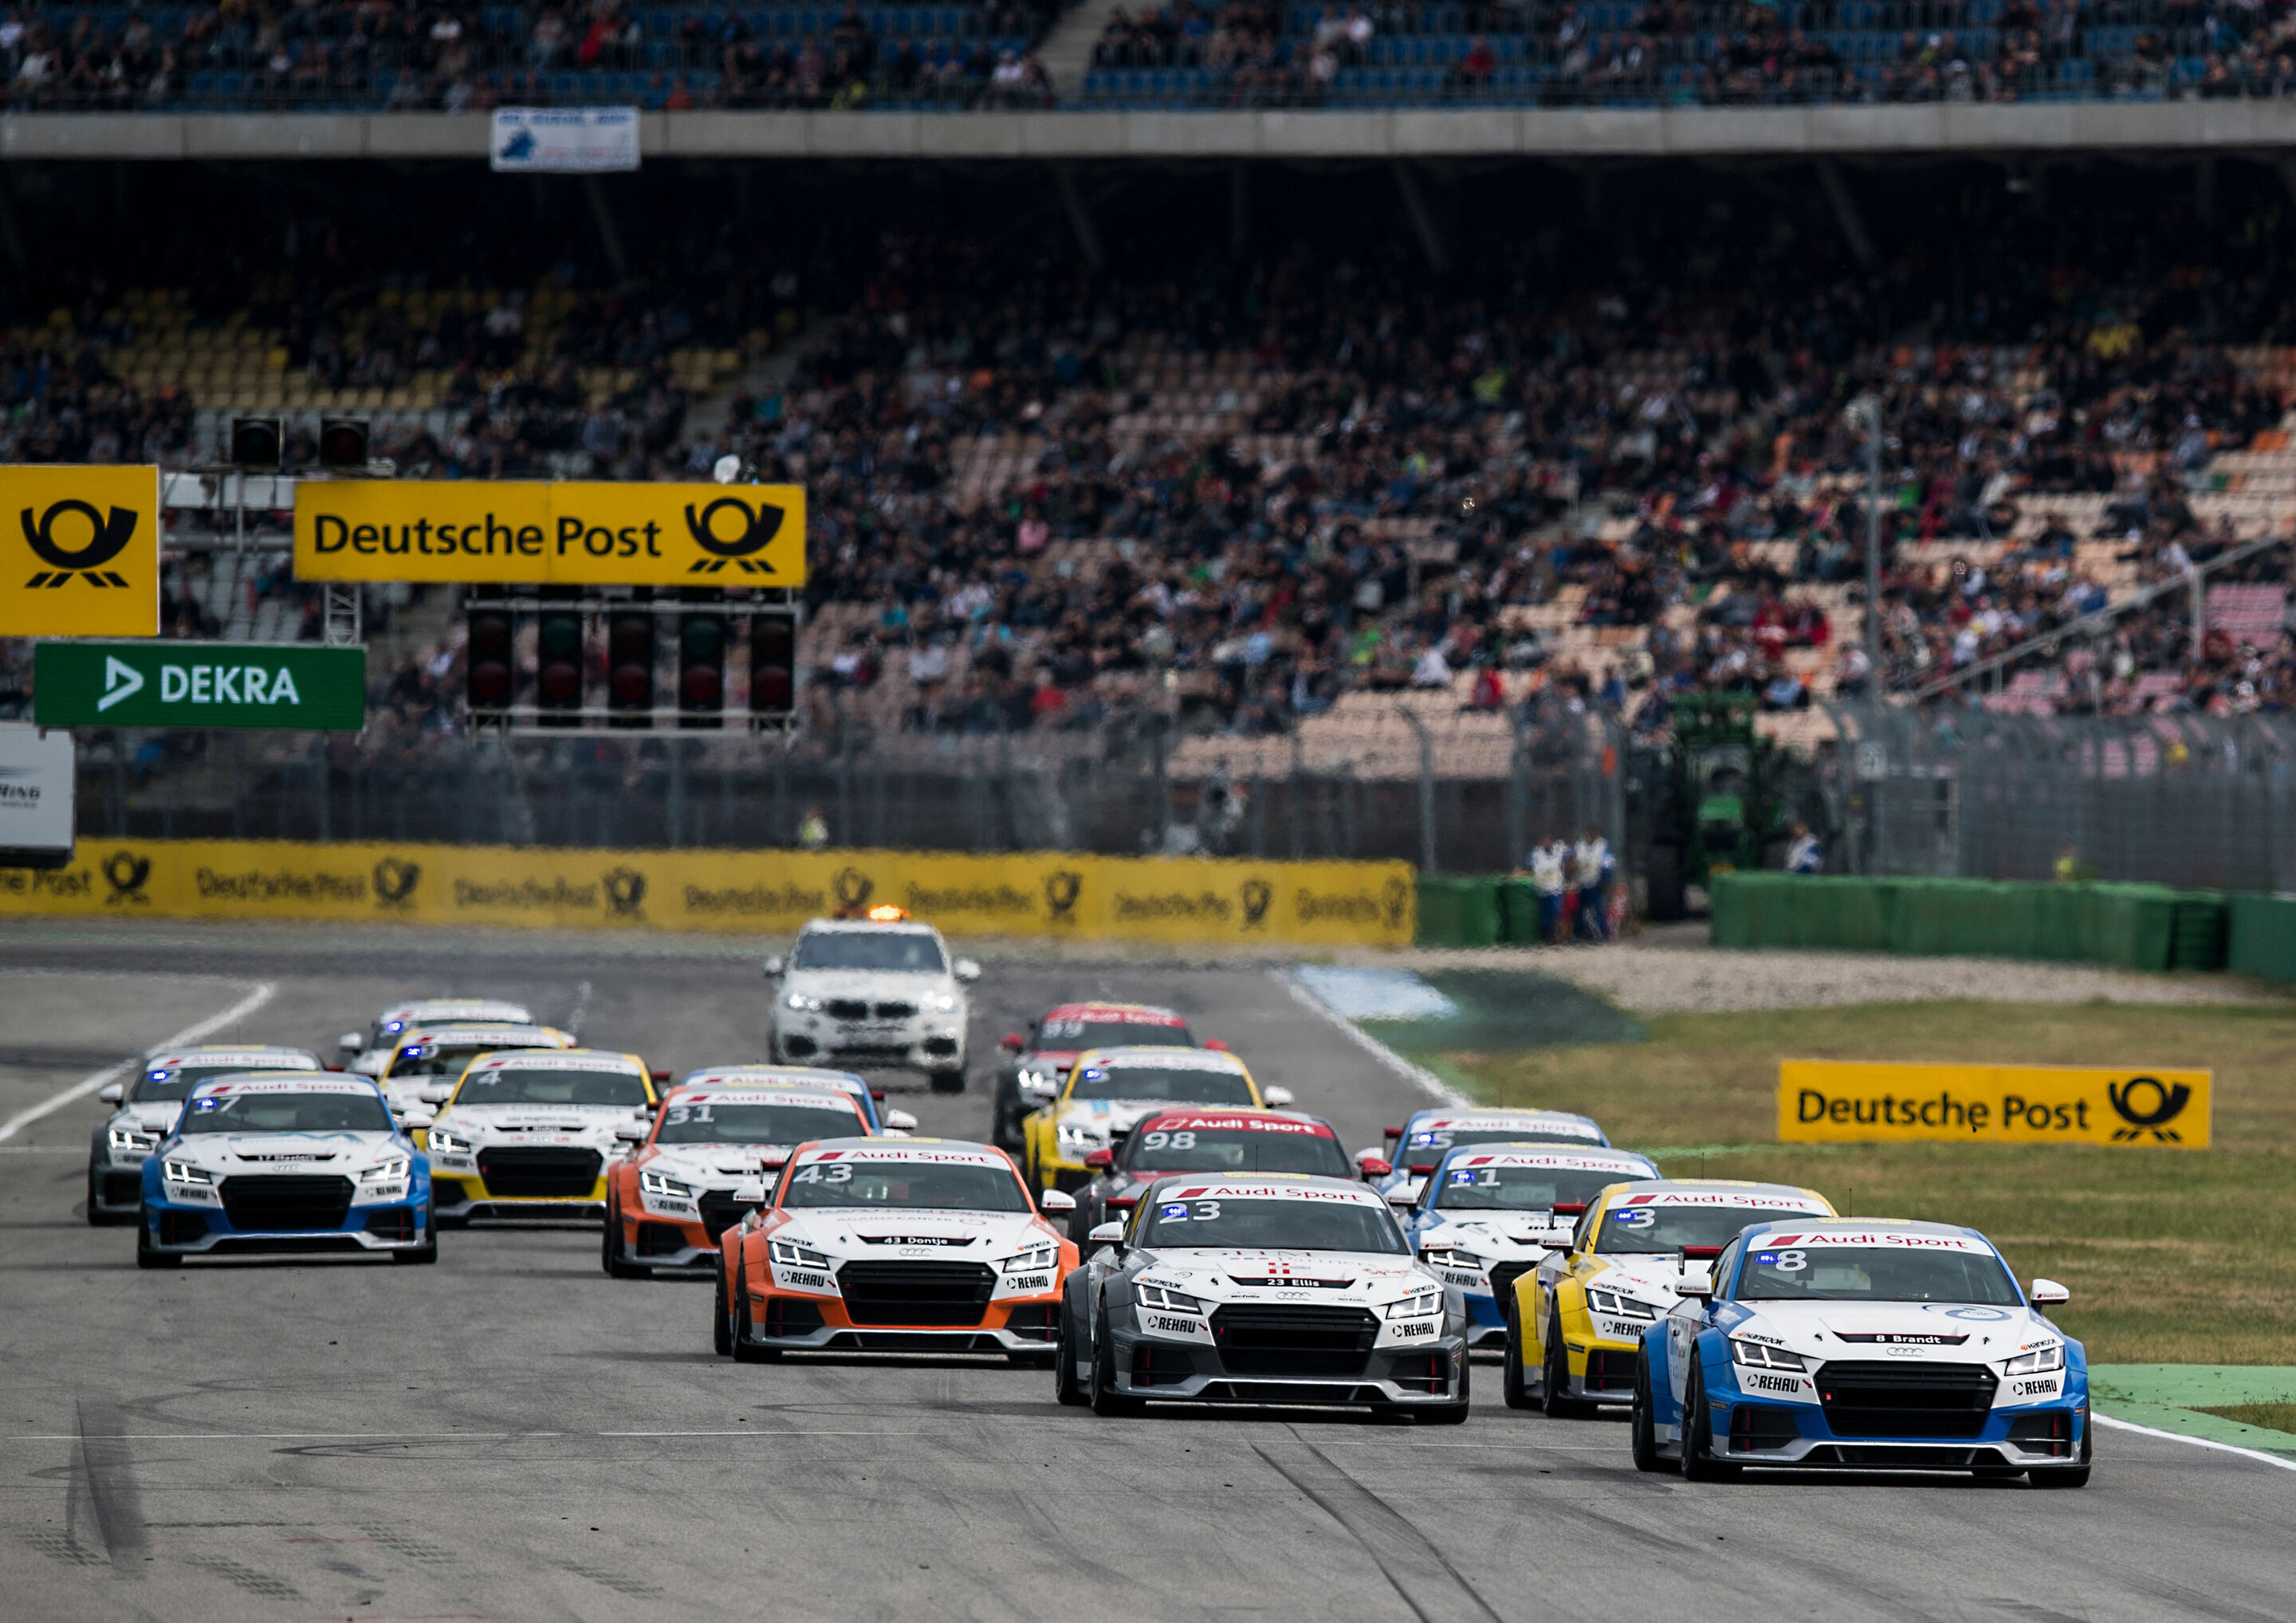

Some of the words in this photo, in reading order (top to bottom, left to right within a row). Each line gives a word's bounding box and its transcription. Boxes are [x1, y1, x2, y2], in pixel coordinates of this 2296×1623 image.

[313, 513, 544, 556] Deutsche
[556, 517, 662, 557] Post
[161, 665, 299, 704] DEKRA
[478, 1070, 501, 1086] 4
[775, 1096, 836, 1106] Sport
[1797, 1087, 1991, 1128] Deutsche
[2003, 1094, 2091, 1130] Post
[666, 1106, 715, 1126] 31
[1189, 1118, 1243, 1128] Audi
[1248, 1120, 1315, 1134] Sport
[1144, 1131, 1196, 1151] 98
[918, 1152, 990, 1164] Sport
[1565, 1158, 1635, 1172] Sport
[793, 1164, 853, 1184] 43
[1215, 1187, 1276, 1196] Audi
[1286, 1189, 1362, 1202] Sport
[1734, 1196, 1809, 1209] Sport
[1159, 1201, 1221, 1224] 23
[1628, 1208, 1655, 1228] 3
[907, 1237, 948, 1246] Dontje
[1809, 1235, 1875, 1244] Audi
[1885, 1236, 1969, 1249] Sport
[1775, 1249, 1807, 1271] 8
[791, 1272, 825, 1287] REHAU
[1018, 1275, 1048, 1289] REHAU
[1445, 1271, 1477, 1287] REHAU
[1158, 1317, 1196, 1333] REHAU
[1404, 1322, 1434, 1337] REHAU
[1614, 1323, 1646, 1337] REHA
[1893, 1335, 1942, 1345] Brandt
[1759, 1375, 1800, 1393] REHAU
[2025, 1379, 2058, 1395] REHAU
